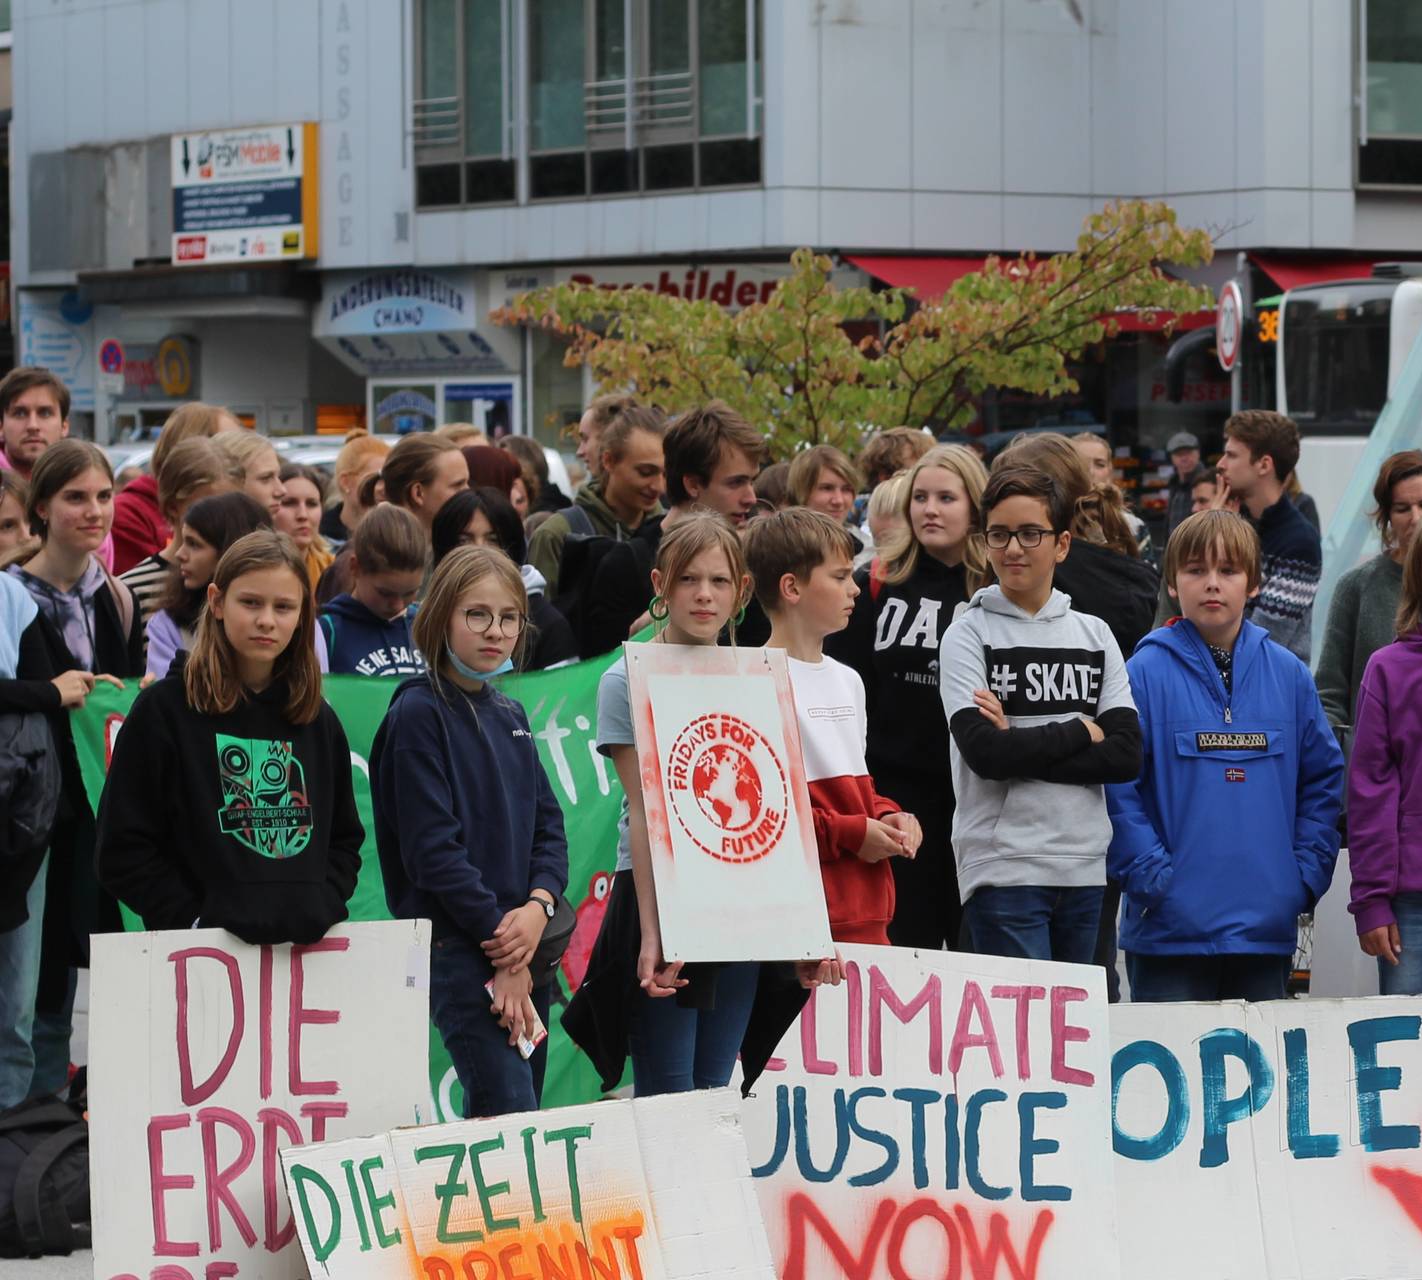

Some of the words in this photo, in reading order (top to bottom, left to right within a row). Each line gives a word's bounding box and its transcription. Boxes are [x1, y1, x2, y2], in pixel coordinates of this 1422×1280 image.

[390, 645, 422, 665] SAIS
[1025, 662, 1101, 704] SKATE
[673, 722, 718, 790] FRIDAYS
[721, 721, 756, 752] FOR
[721, 807, 780, 855] FUTURE
[167, 936, 351, 1107] DIE
[750, 1084, 1073, 1202] JUSTICE
[290, 1155, 402, 1273] DIE
[414, 1122, 592, 1244] ZEIT
[780, 1192, 1056, 1280] NOW
